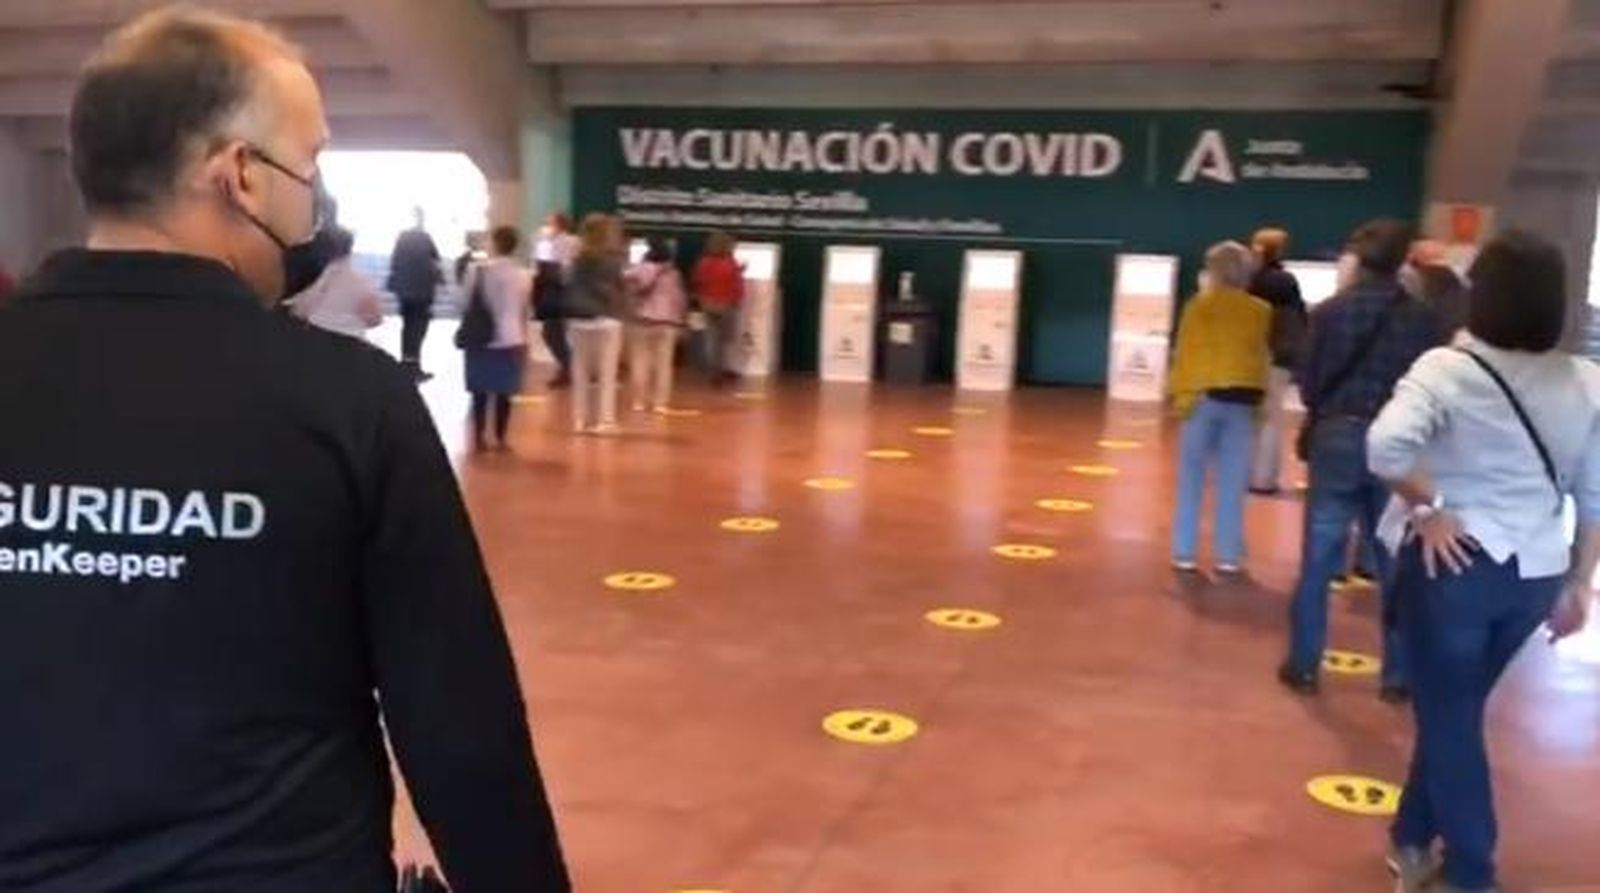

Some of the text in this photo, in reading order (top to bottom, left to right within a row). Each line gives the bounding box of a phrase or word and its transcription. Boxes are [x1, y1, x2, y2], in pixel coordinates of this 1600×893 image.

[619, 122, 1123, 178] VACUNACIÓN COVID
[0, 541, 187, 583] enKeeper
